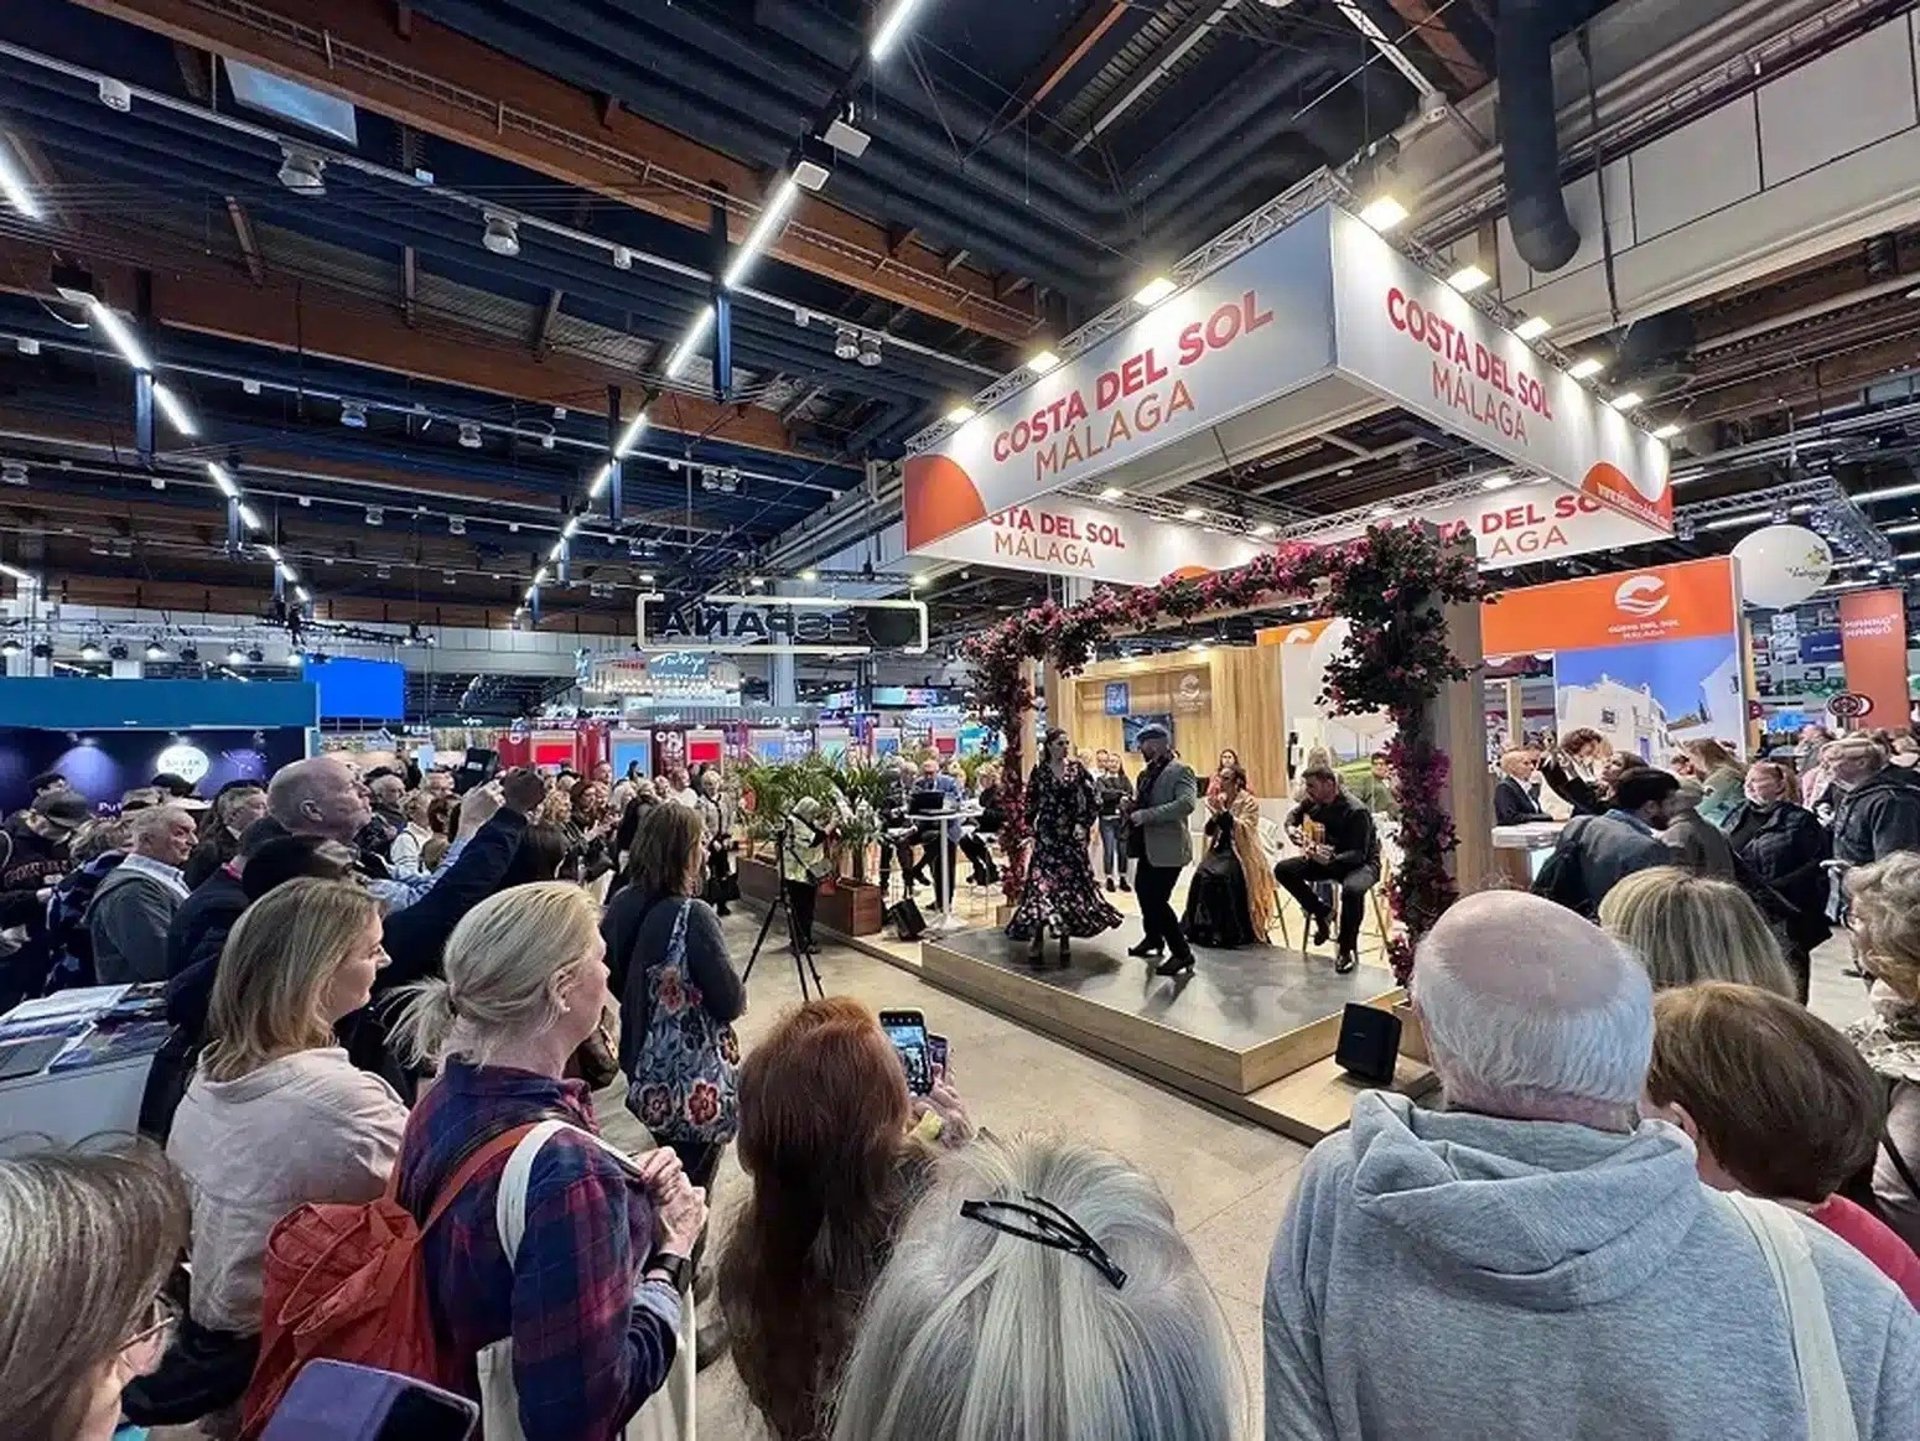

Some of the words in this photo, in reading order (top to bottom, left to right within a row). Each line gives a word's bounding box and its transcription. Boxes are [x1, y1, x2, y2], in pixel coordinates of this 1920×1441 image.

[992, 390, 1089, 463] COSTA
[1096, 347, 1168, 411] DEL
[1178, 289, 1274, 367] SOL
[1387, 287, 1471, 372] COSTA
[1475, 342, 1515, 398] DEL
[1517, 371, 1554, 423] SOL
[1034, 378, 1196, 482] MÁLAGA
[1432, 360, 1529, 447] MÁLAGA
[994, 530, 1096, 569] MÁLAGA
[1040, 512, 1082, 541] DEL
[1085, 522, 1126, 549] SOL
[1481, 502, 1546, 536] DEL
